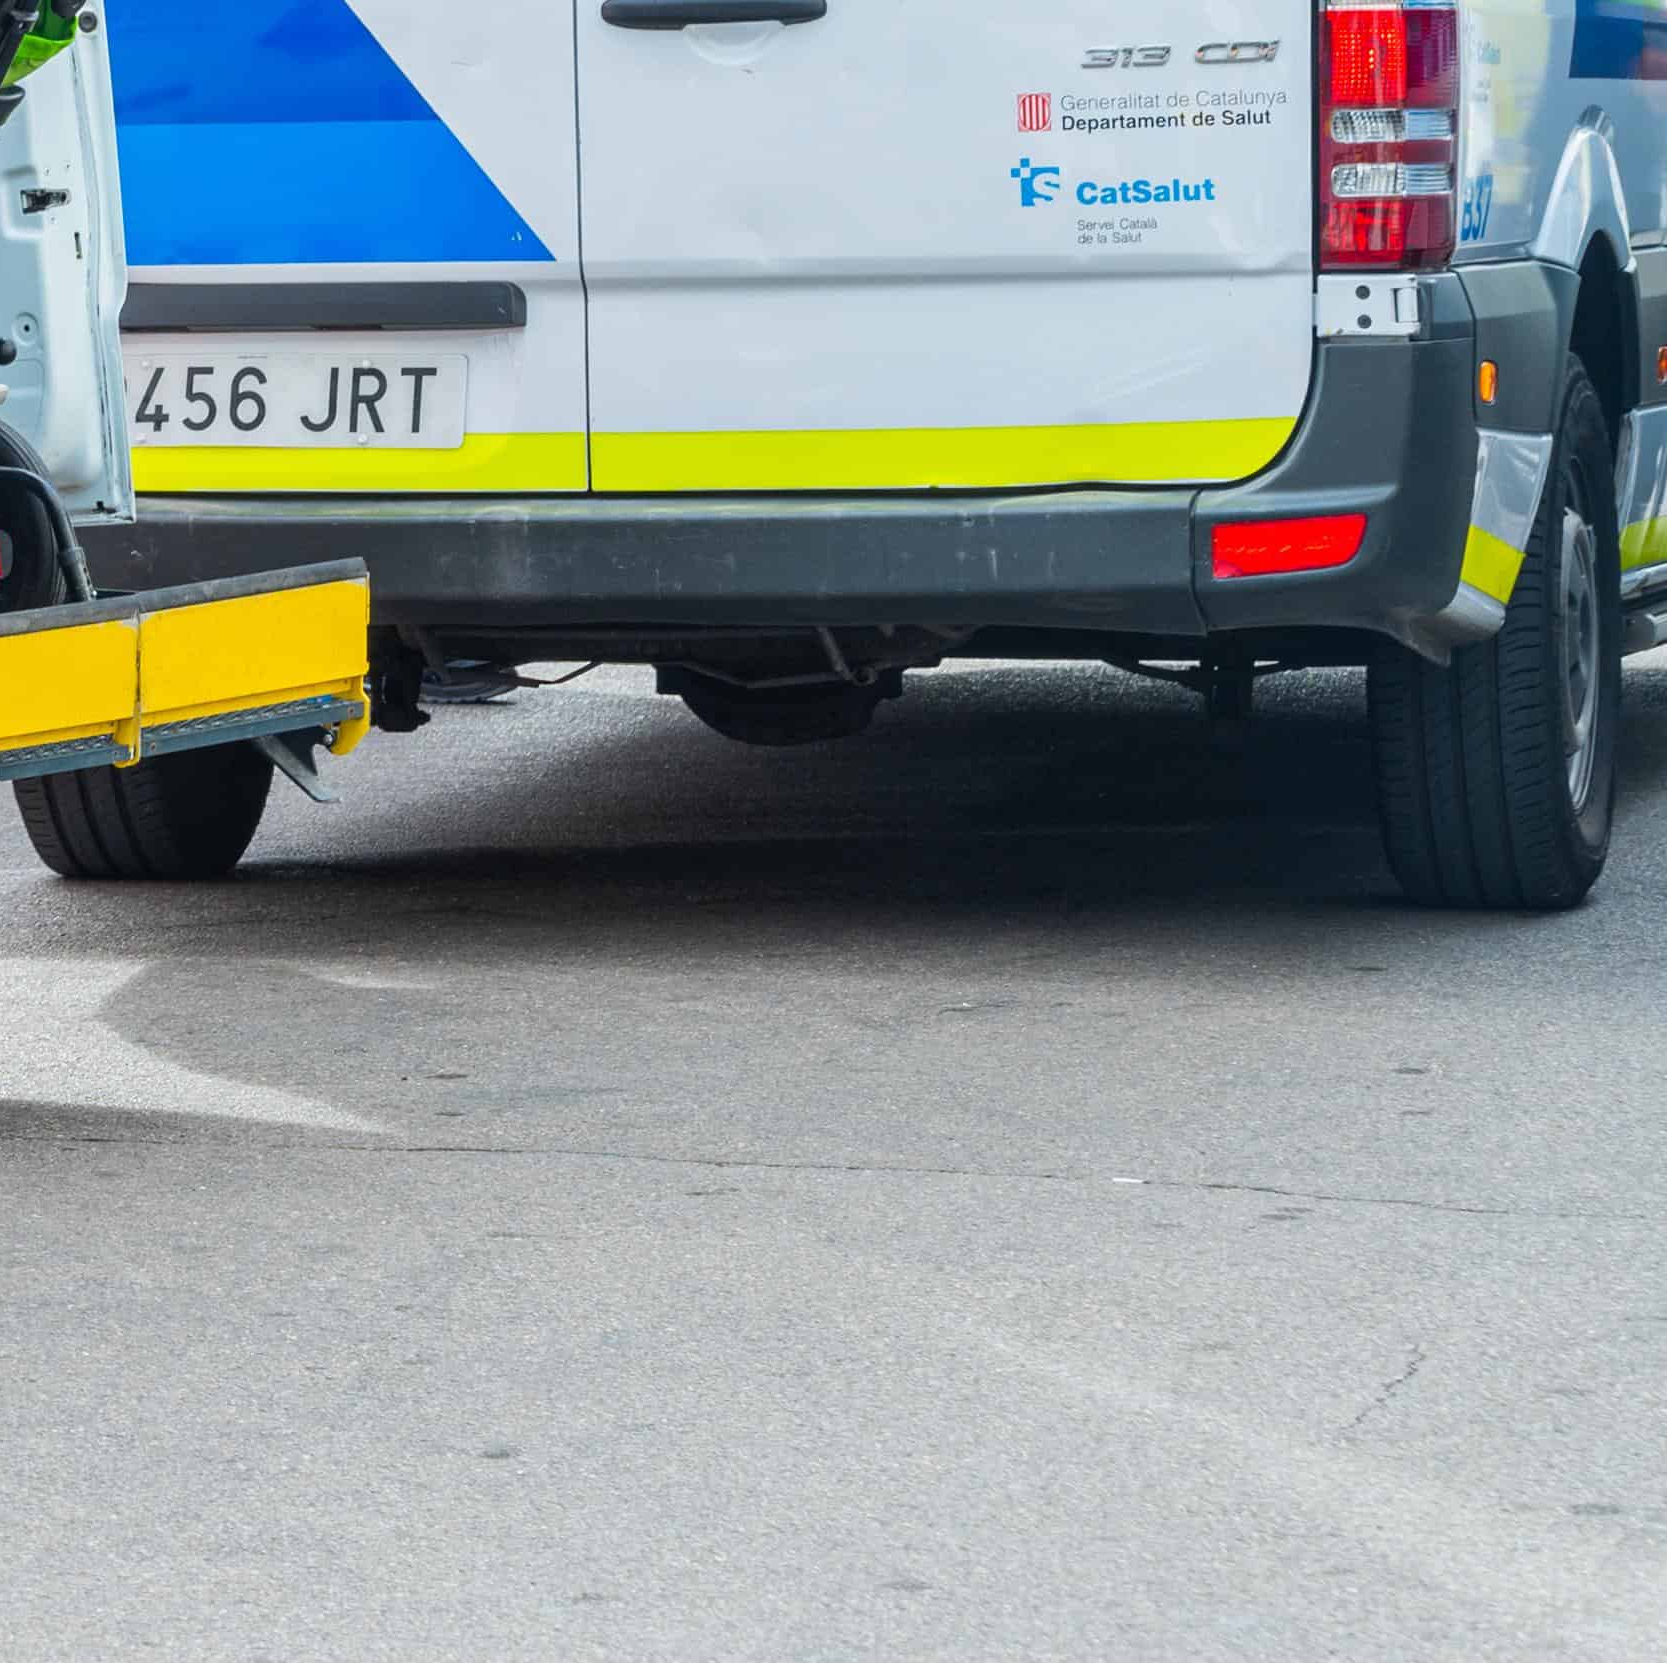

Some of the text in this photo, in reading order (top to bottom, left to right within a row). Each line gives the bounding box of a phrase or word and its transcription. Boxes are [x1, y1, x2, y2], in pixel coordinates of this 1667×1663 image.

[1080, 44, 1172, 69] 313
[1060, 89, 1288, 111] Generalitat de Catalunya
[1062, 109, 1272, 134] Departament de Salut
[1076, 178, 1216, 206] CatSalut
[124, 366, 438, 434] 456 JRT
